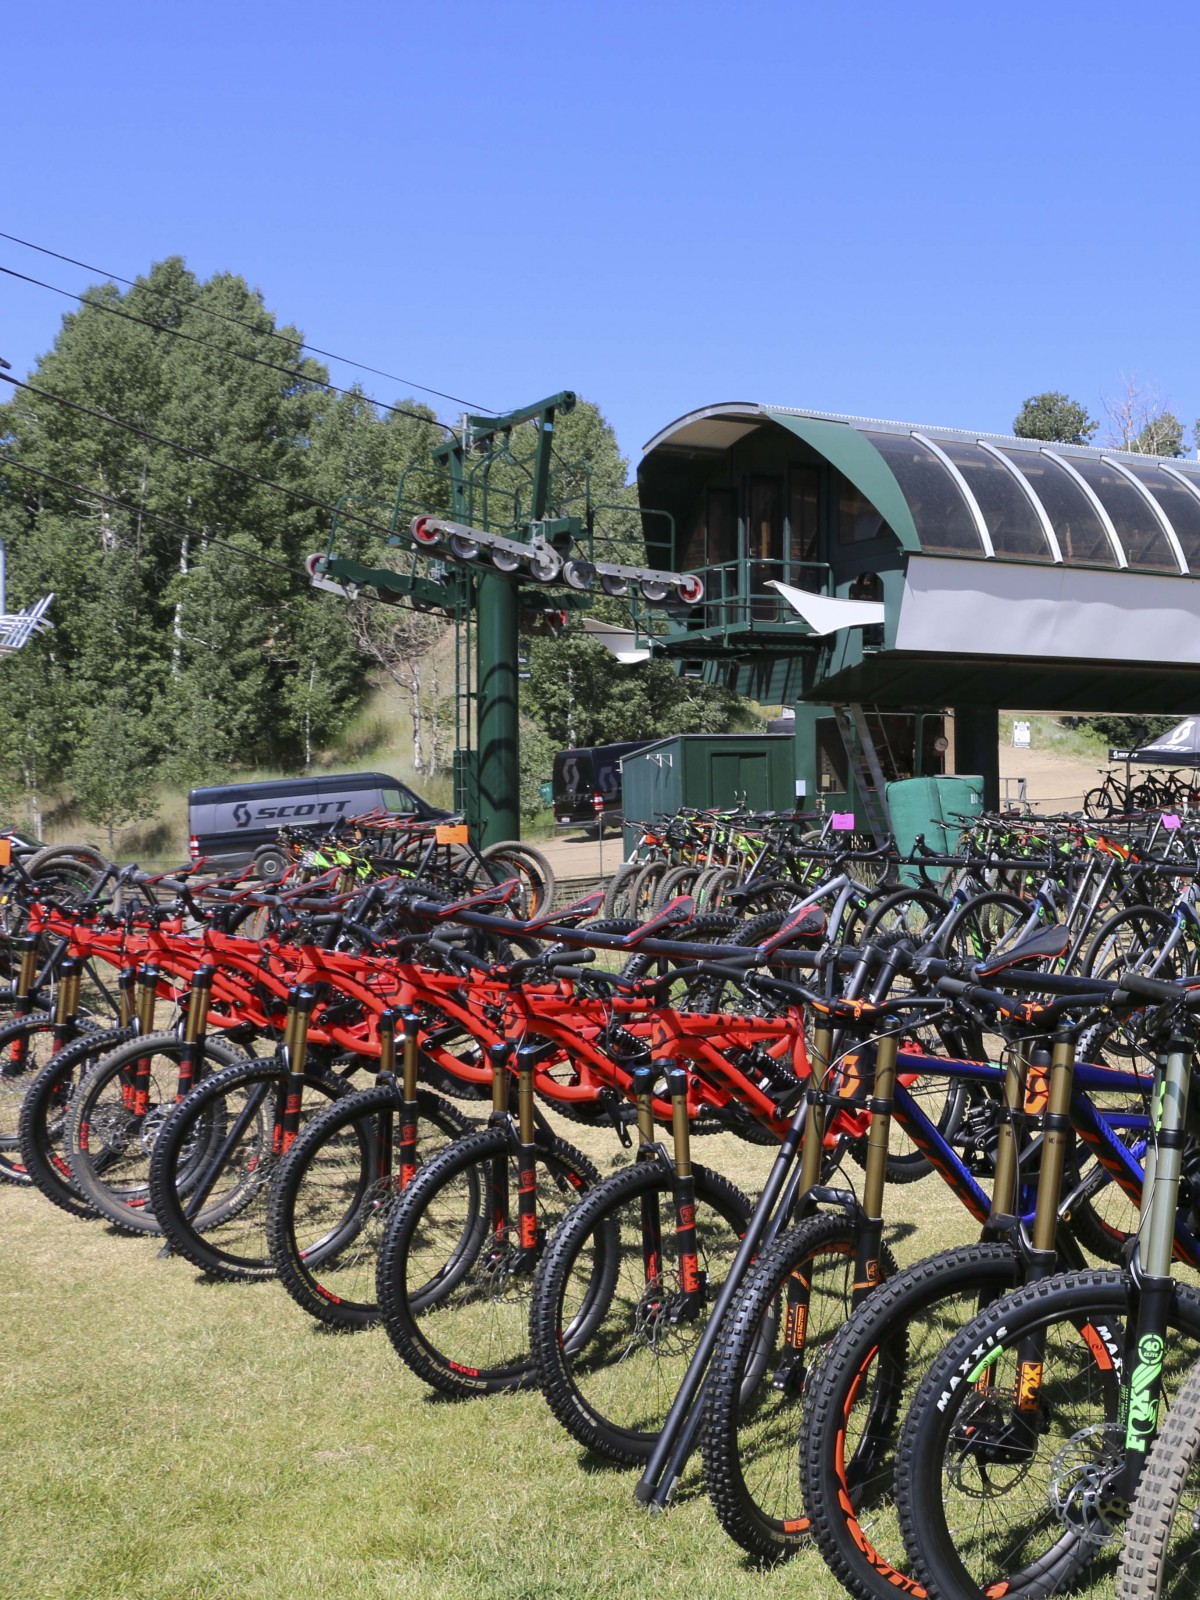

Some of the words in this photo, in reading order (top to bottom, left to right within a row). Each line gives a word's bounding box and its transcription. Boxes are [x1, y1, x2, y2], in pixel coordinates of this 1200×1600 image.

[254, 800, 351, 820] SCOTT
[477, 1172, 488, 1218] MAGIC
[522, 1213, 537, 1248] FOX
[683, 1253, 699, 1293] FOX
[410, 1336, 488, 1390] SCHWALBE
[1143, 1340, 1160, 1352] 40
[936, 1326, 1008, 1413] MAXXIS
[1022, 1363, 1042, 1411] FOX
[1127, 1390, 1160, 1454] FOX
